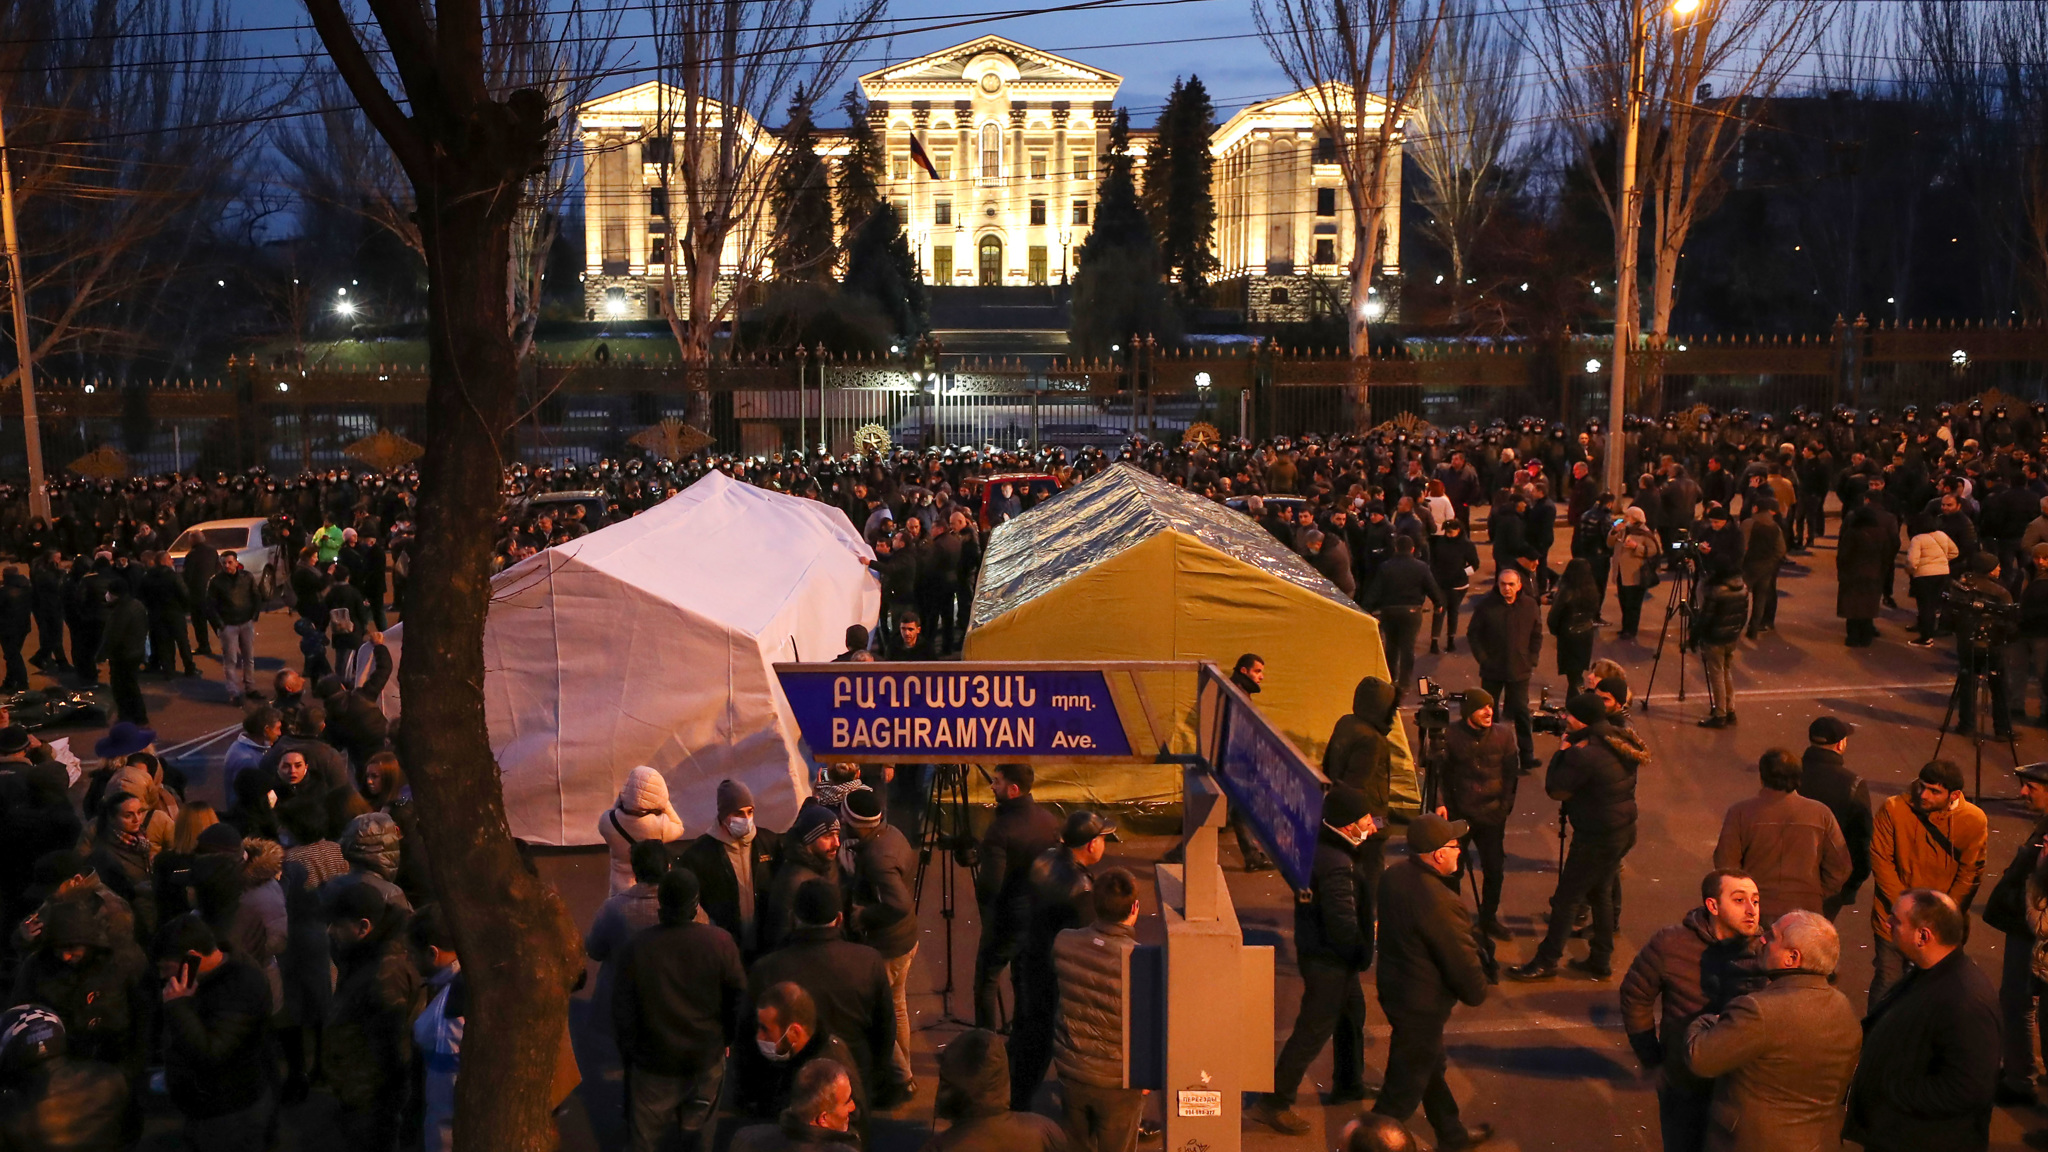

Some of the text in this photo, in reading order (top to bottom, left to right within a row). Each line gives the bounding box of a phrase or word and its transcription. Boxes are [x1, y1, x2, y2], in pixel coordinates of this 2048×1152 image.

[833, 675, 1097, 712] ԲԱՂՐԱՄՅԱՆ պող.
[832, 717, 1097, 749] BAGHRAMYAN Ave.
